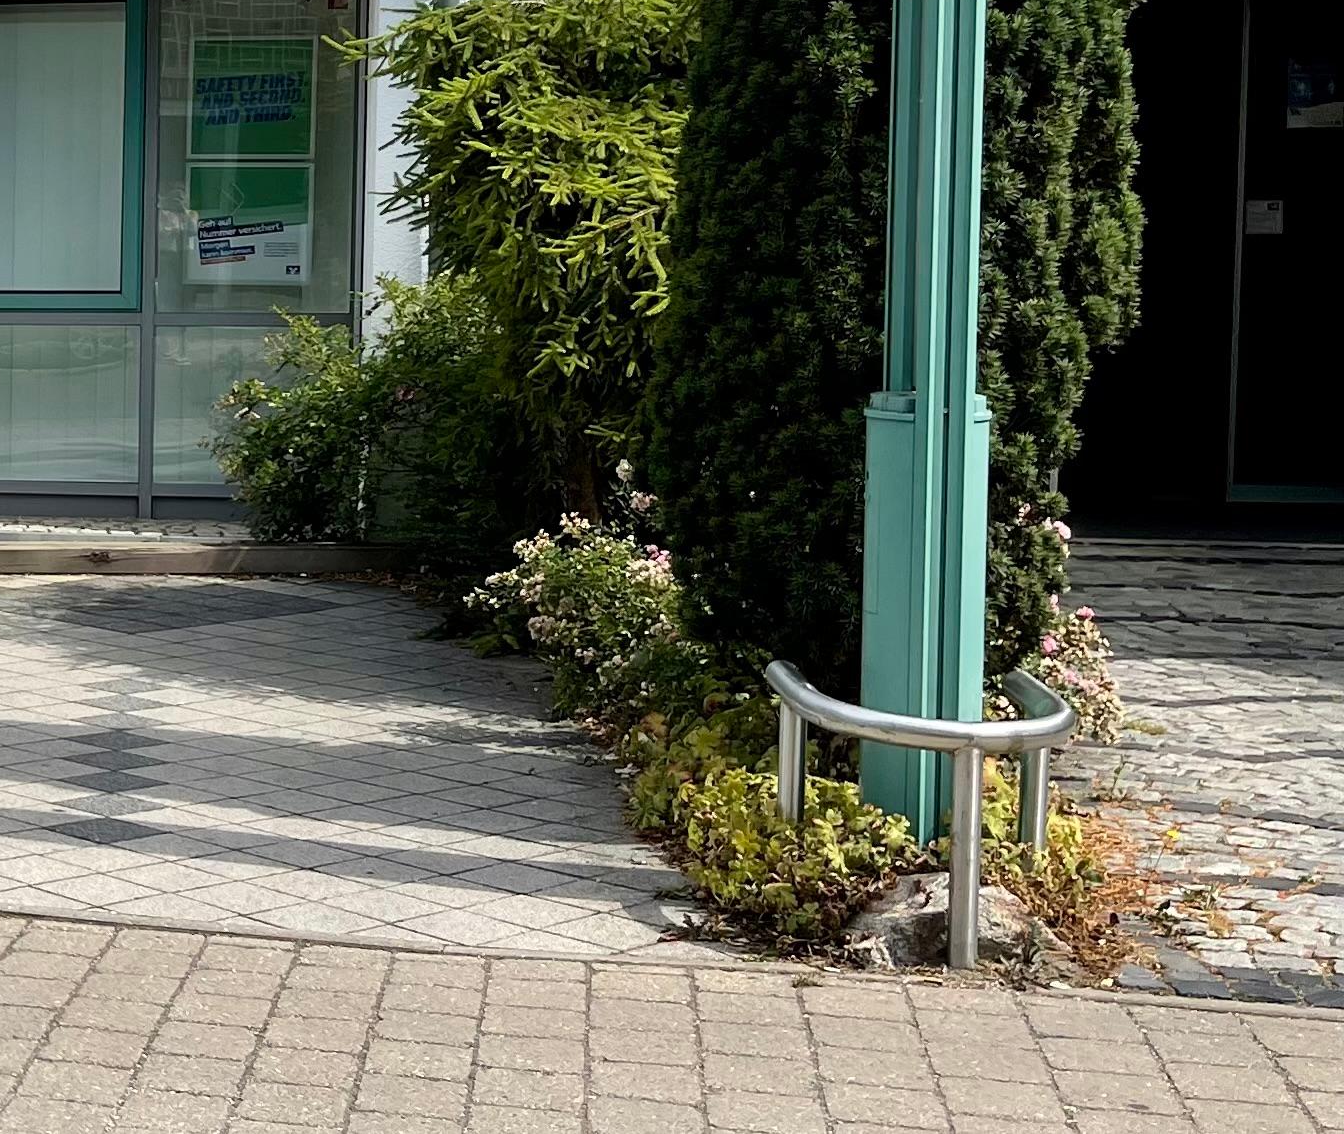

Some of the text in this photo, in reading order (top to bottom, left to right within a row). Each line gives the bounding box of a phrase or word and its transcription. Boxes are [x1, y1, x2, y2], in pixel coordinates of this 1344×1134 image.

[195, 71, 308, 95] SAFETY FIRST.
[201, 87, 306, 109] AND SECOND.
[205, 105, 297, 126] AND THIRD.
[199, 223, 283, 239] Nummer versichert.
